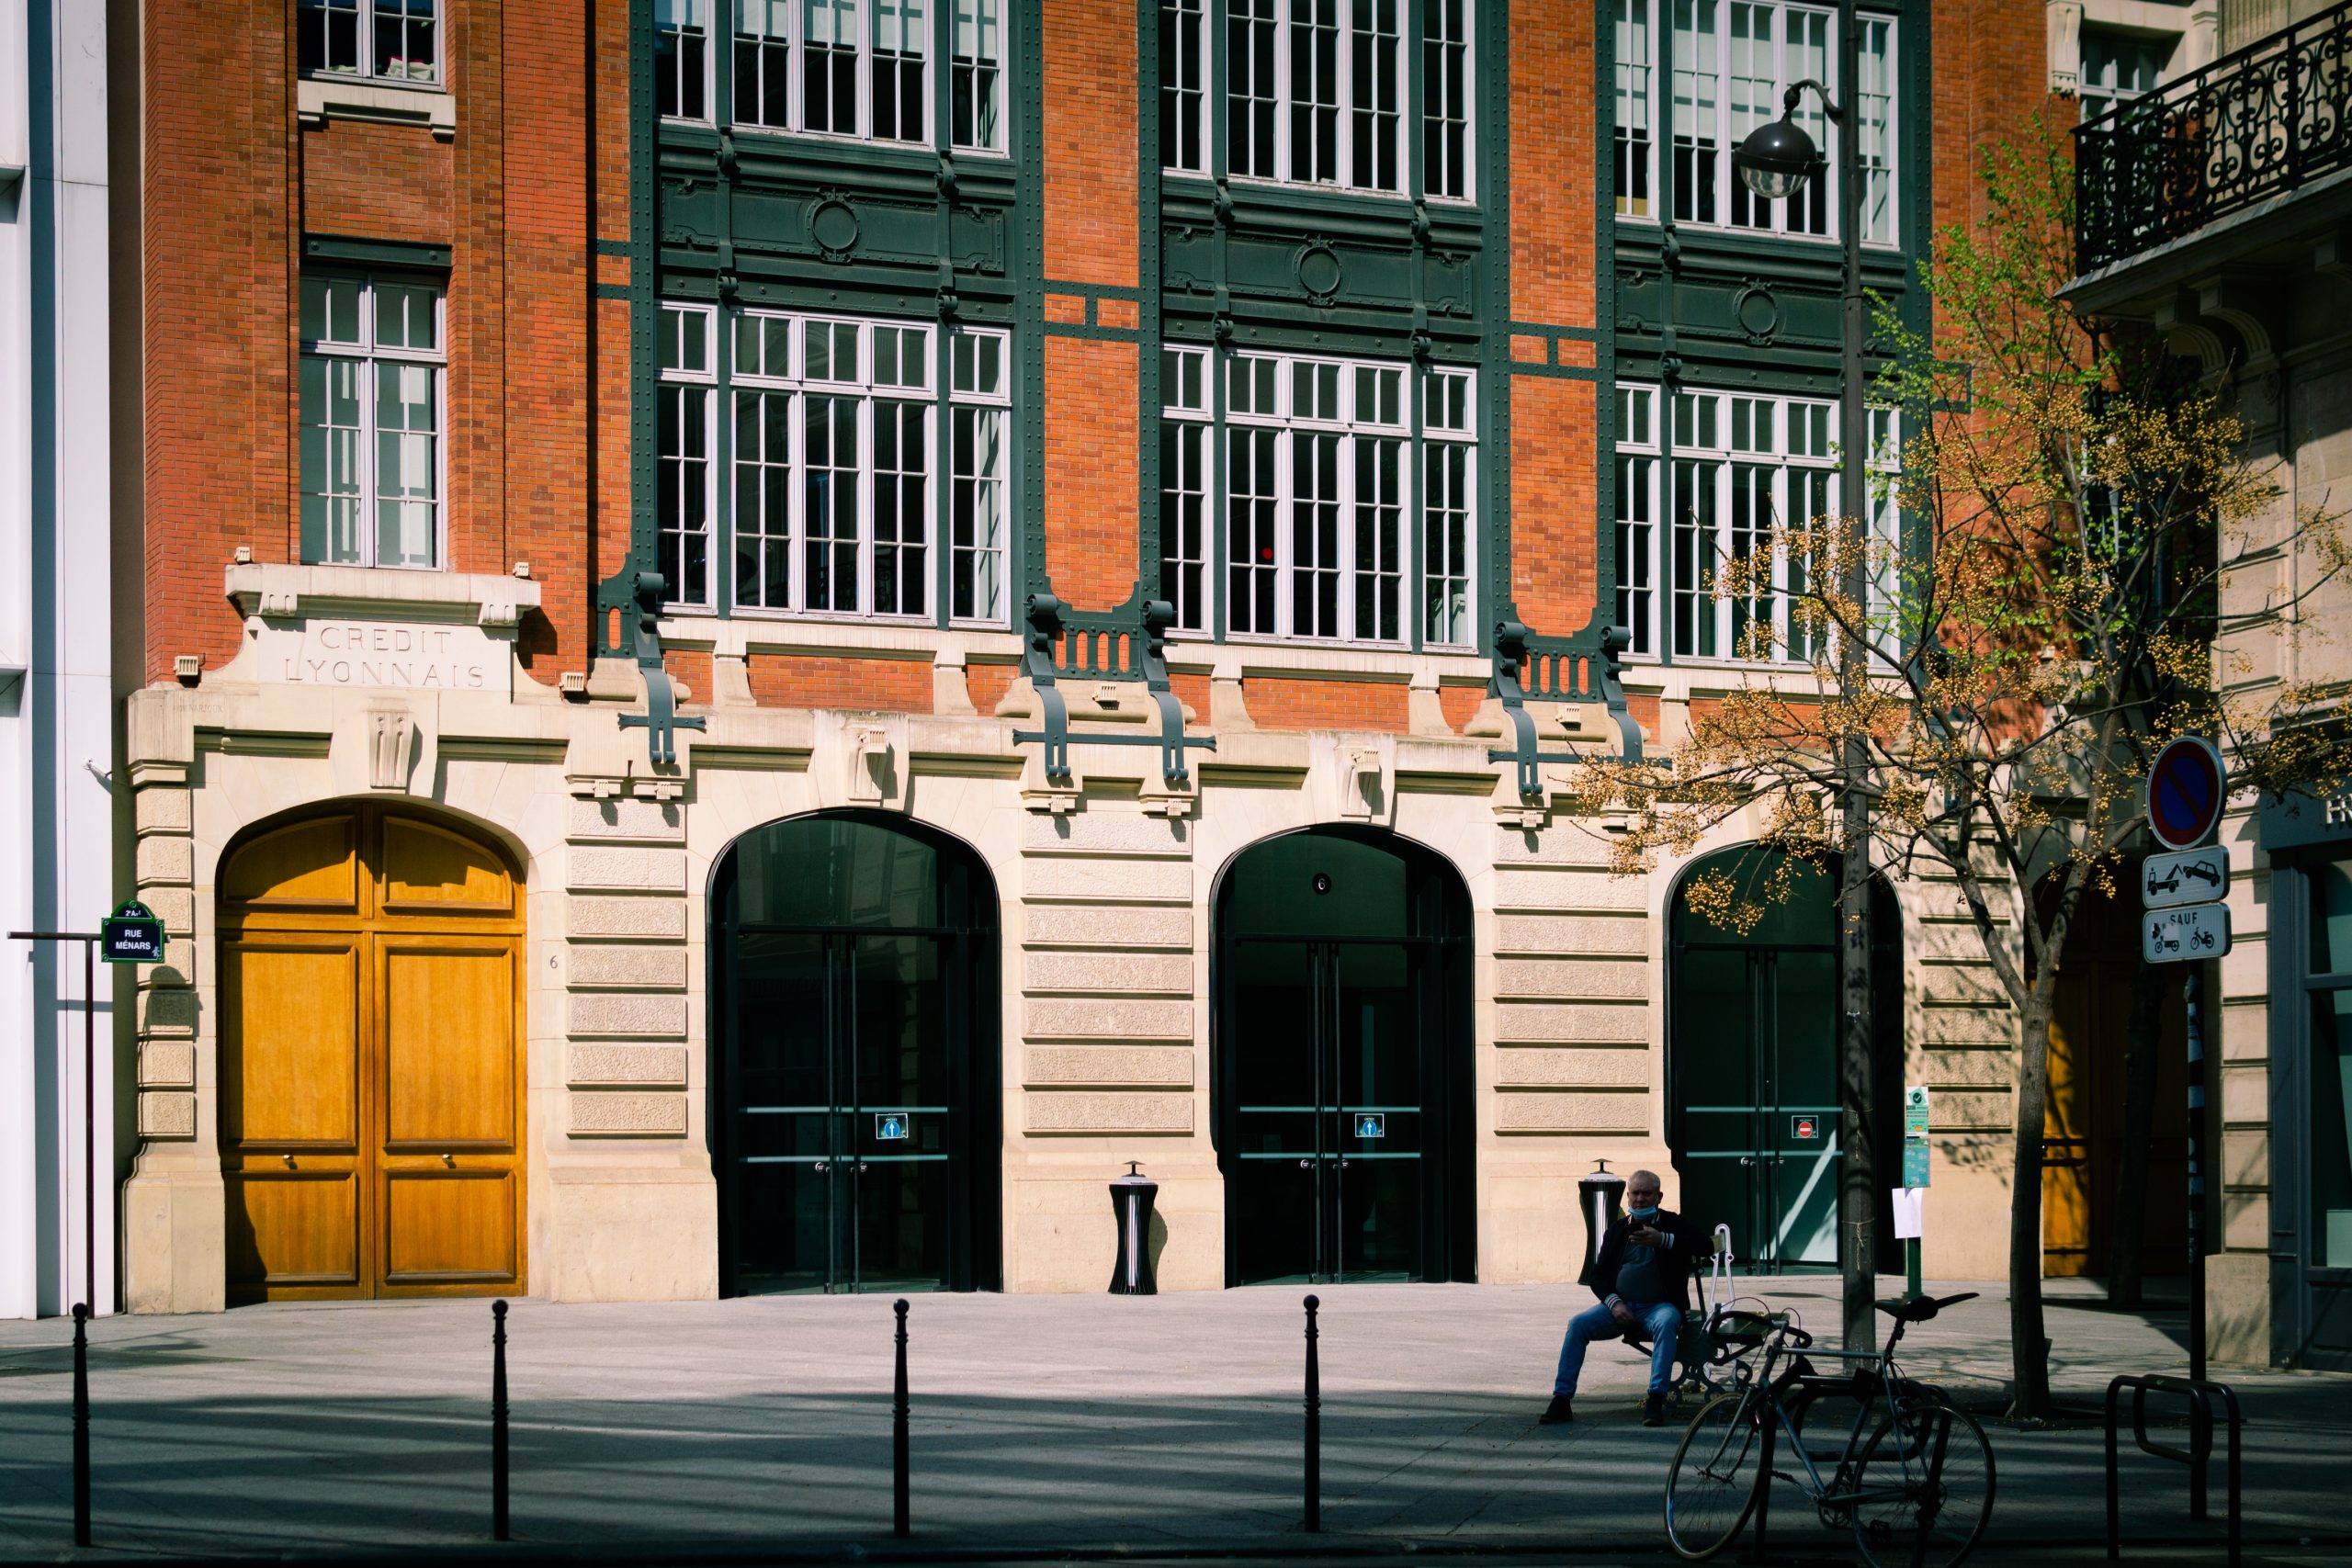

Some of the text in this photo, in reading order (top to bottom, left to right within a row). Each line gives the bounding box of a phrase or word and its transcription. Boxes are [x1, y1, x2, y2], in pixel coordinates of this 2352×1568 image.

[320, 626, 451, 654] CREDIT
[285, 659, 485, 688] LYONNAIS
[1317, 878, 1326, 891] 6
[2170, 912, 2198, 926] SAUF
[124, 929, 142, 938] RUE
[115, 939, 152, 950] MÉNARS
[549, 954, 559, 969] 6
